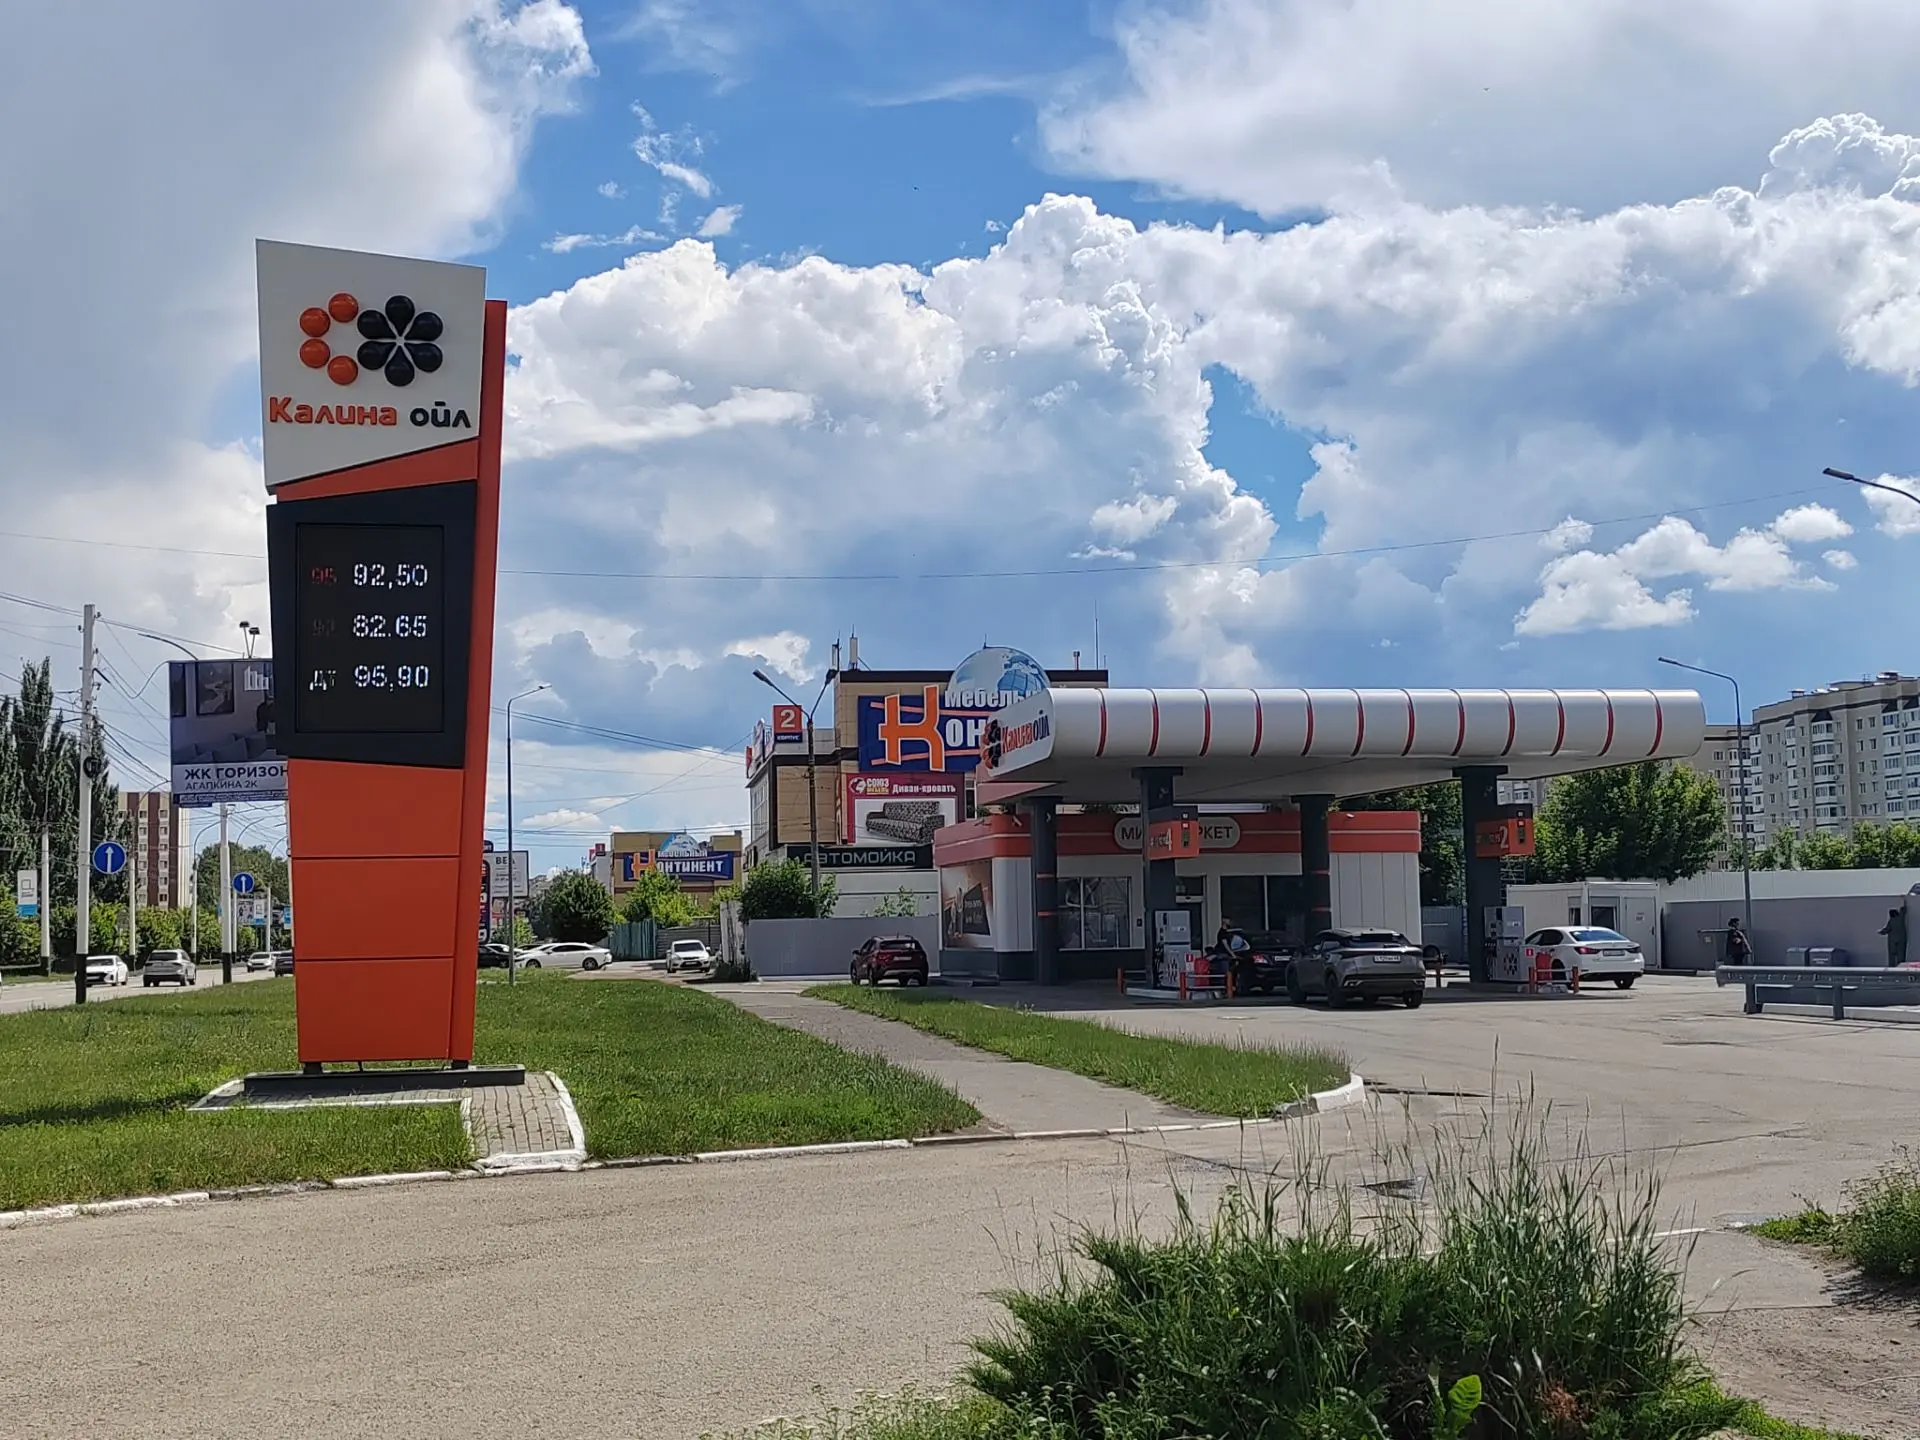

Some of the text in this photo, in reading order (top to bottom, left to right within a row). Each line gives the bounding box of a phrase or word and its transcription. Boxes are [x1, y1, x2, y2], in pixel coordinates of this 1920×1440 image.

[268, 396, 471, 428] Калина ойл
[353, 563, 428, 589] 92,50
[352, 614, 427, 638] 82.65
[780, 709, 796, 728] 2
[1001, 723, 1033, 754] Калина
[184, 767, 212, 780] ЖК
[866, 777, 890, 786] СОЮЗ
[185, 779, 258, 791] АГАПКИНА 2К
[891, 783, 956, 795] Диван-кровать
[1498, 825, 1509, 849] 2
